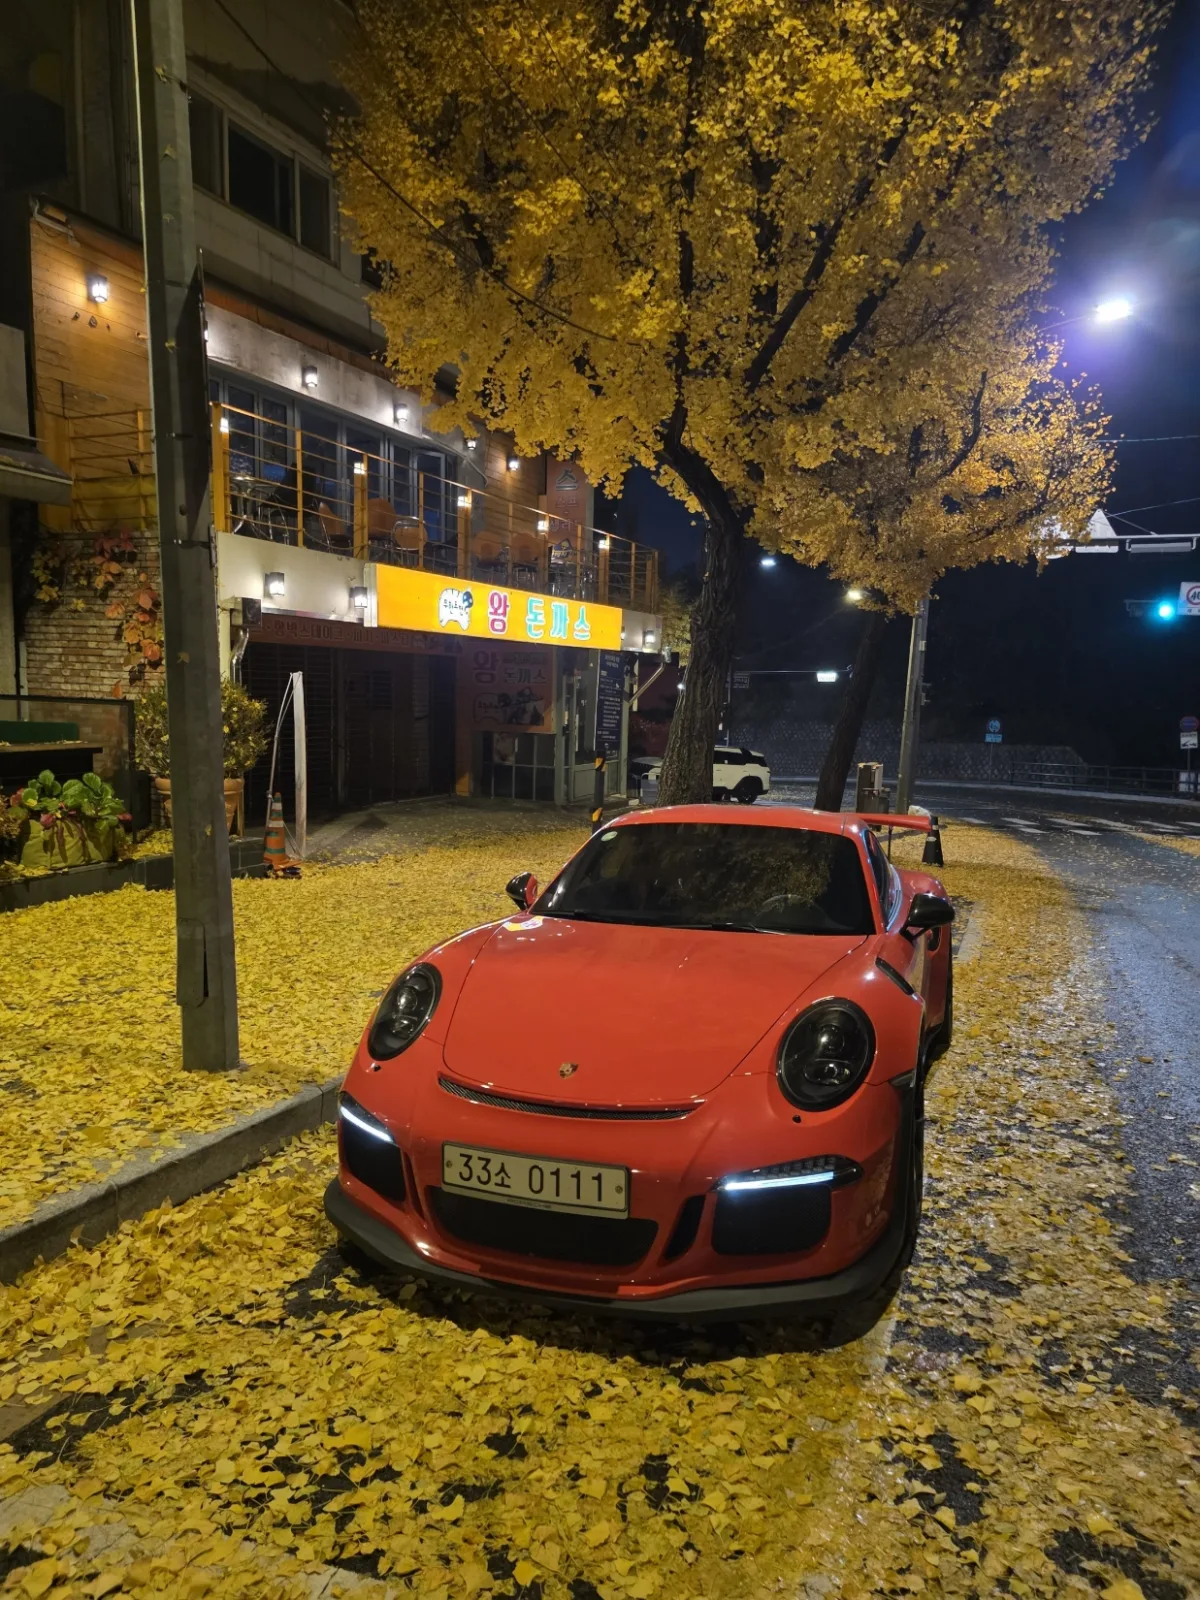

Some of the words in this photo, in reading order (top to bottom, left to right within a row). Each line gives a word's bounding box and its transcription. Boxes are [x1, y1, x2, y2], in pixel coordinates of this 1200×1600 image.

[488, 591, 510, 633] 왕
[526, 597, 590, 639] 돈까스
[472, 650, 499, 683] 왕
[503, 667, 547, 684] 돈까스
[458, 1152, 511, 1188] 33소
[528, 1164, 603, 1202] 0111
